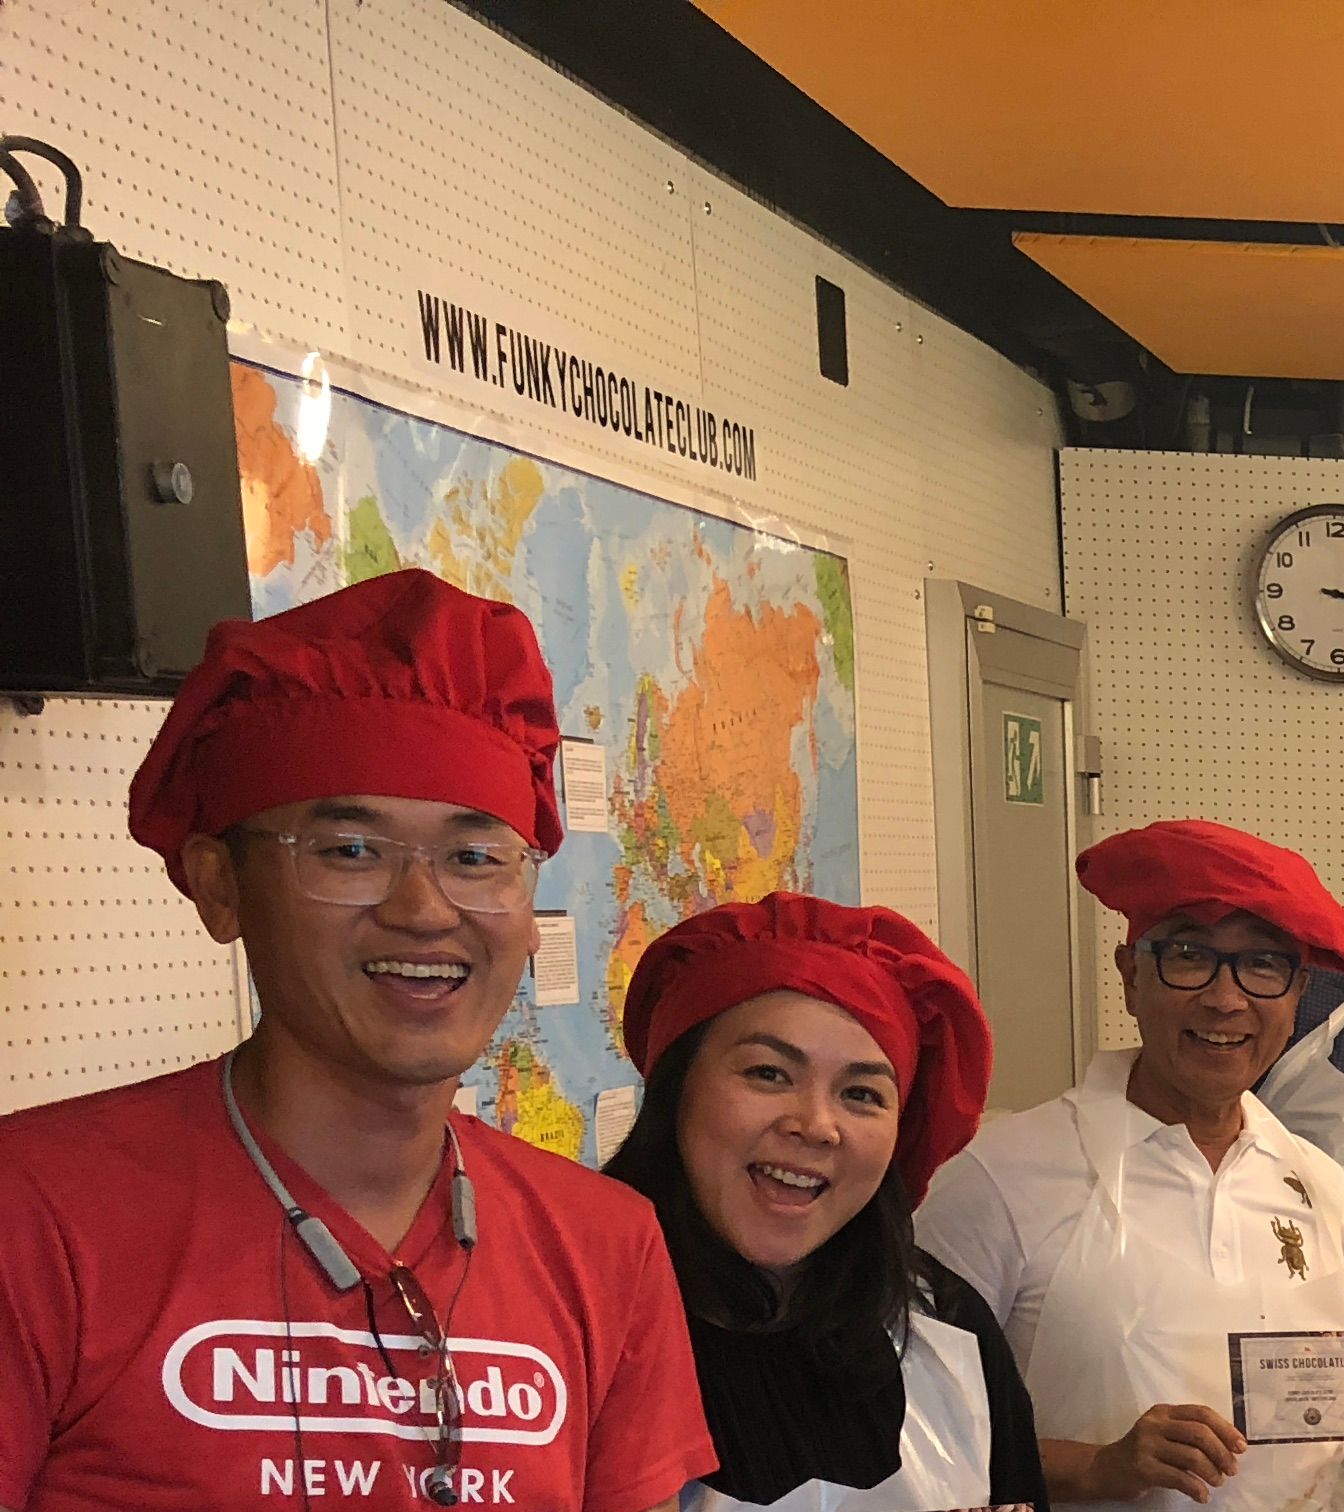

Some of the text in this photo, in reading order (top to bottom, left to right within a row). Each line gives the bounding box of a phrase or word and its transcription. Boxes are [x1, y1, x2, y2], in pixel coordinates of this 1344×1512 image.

[418, 290, 756, 481] WWW.FUNKYCHOCOLATECLUB.COM
[1298, 531, 1310, 547] 11
[1276, 552, 1293, 568] 10
[1266, 584, 1283, 598] 9
[1278, 616, 1295, 630] 8
[1301, 640, 1314, 655] 7
[1260, 1358, 1290, 1369] SWISS
[213, 1347, 542, 1420] Nintendo
[261, 1459, 380, 1496] NEW
